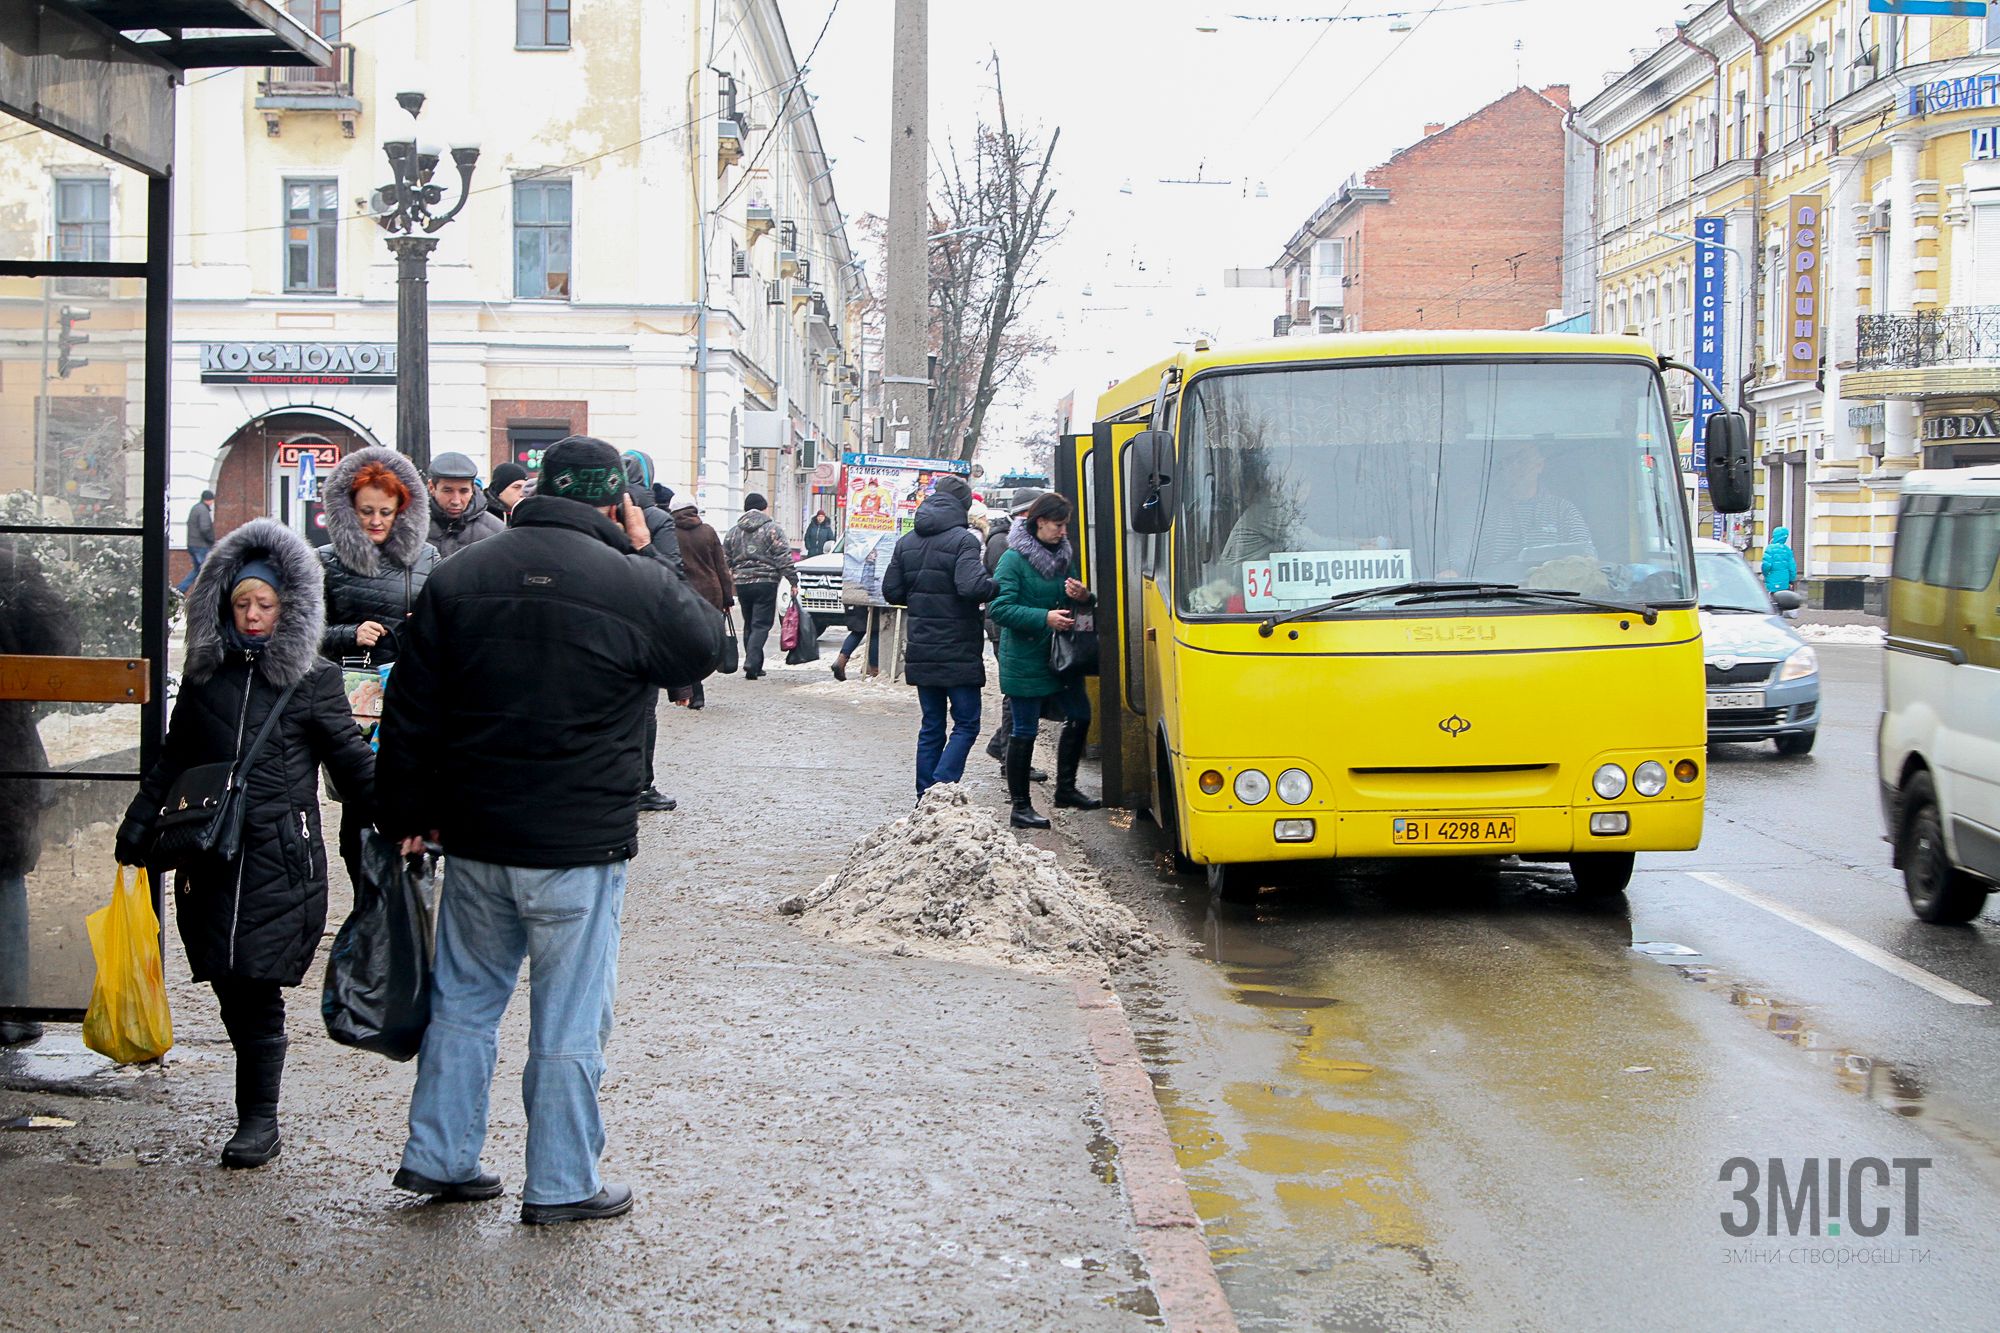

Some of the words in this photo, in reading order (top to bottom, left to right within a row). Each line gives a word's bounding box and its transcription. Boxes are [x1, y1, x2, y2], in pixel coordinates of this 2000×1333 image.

[1924, 75, 2000, 113] КОМП
[1702, 222, 1715, 353] СЕРВІСНИЙ
[201, 343, 397, 371] КОСМОЛОТ
[1926, 416, 2000, 439] ПЕРЛ
[1438, 822, 1480, 840] 4298
[1485, 821, 1511, 839] AA
